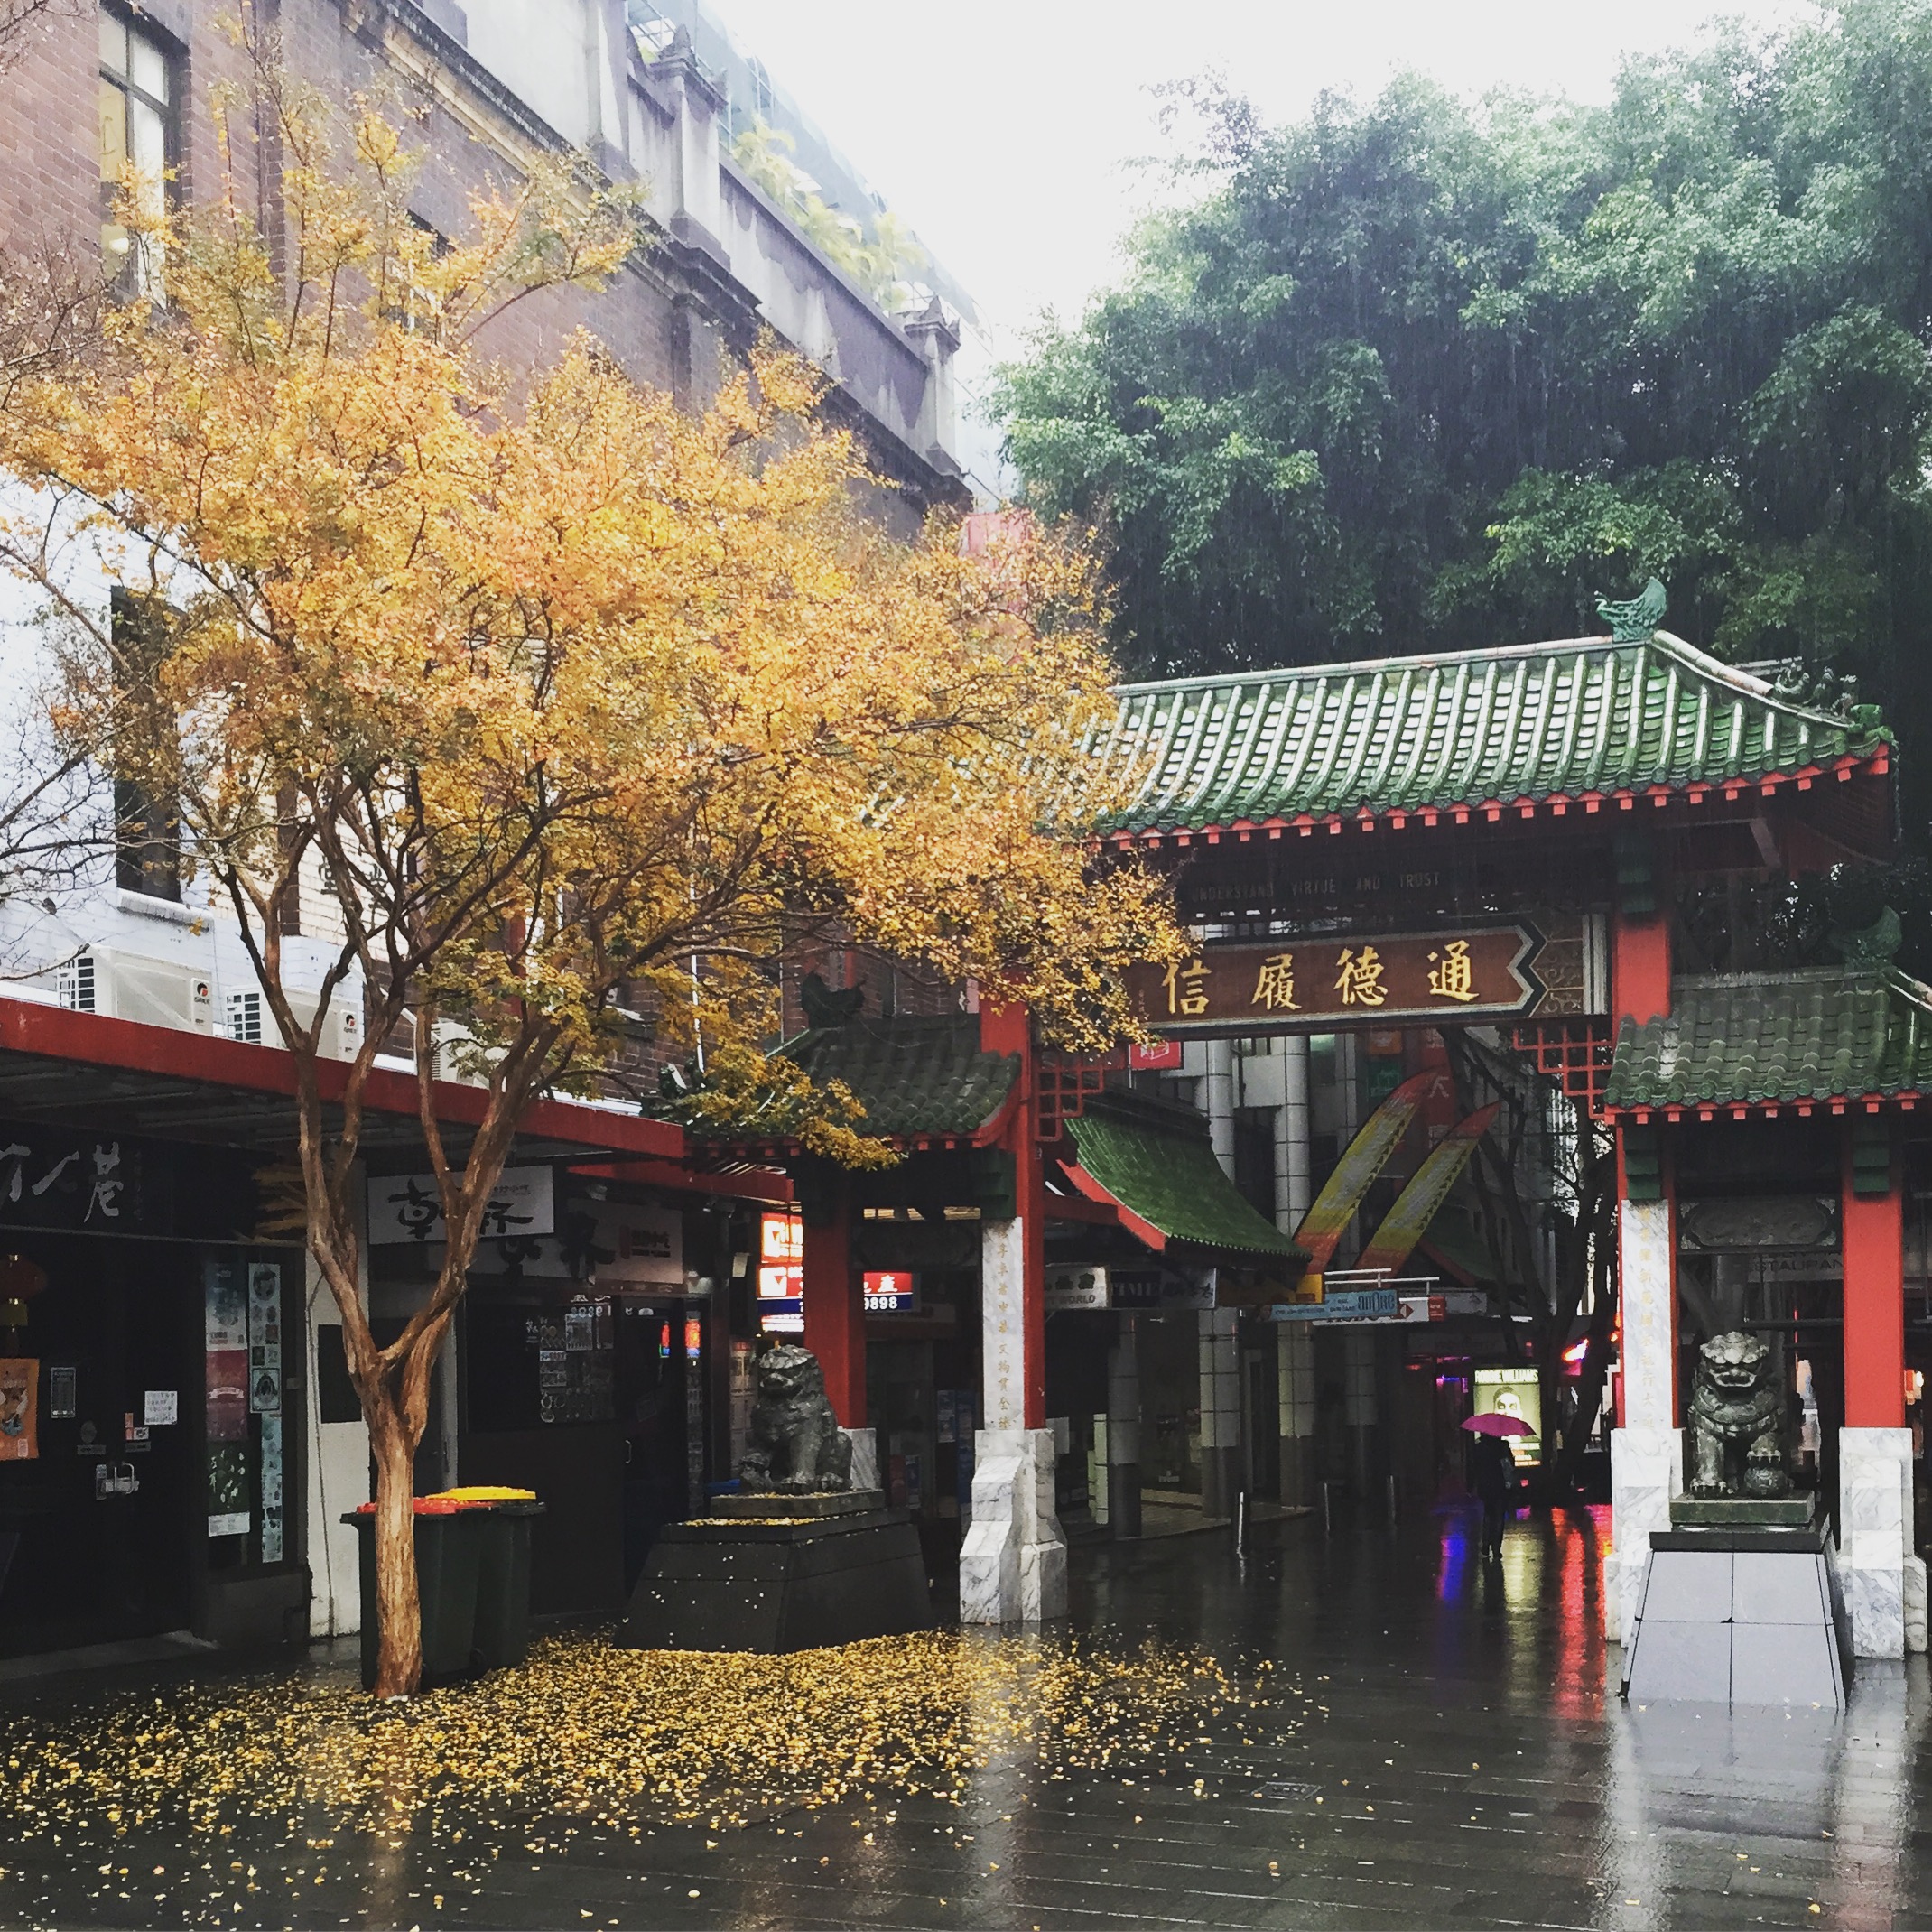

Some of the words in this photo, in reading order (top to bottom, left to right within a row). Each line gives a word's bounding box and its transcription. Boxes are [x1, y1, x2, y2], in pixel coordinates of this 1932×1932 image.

[1290, 878, 1335, 896] VIRTUE
[1356, 875, 1380, 891] AND
[1399, 872, 1440, 888] TRUST
